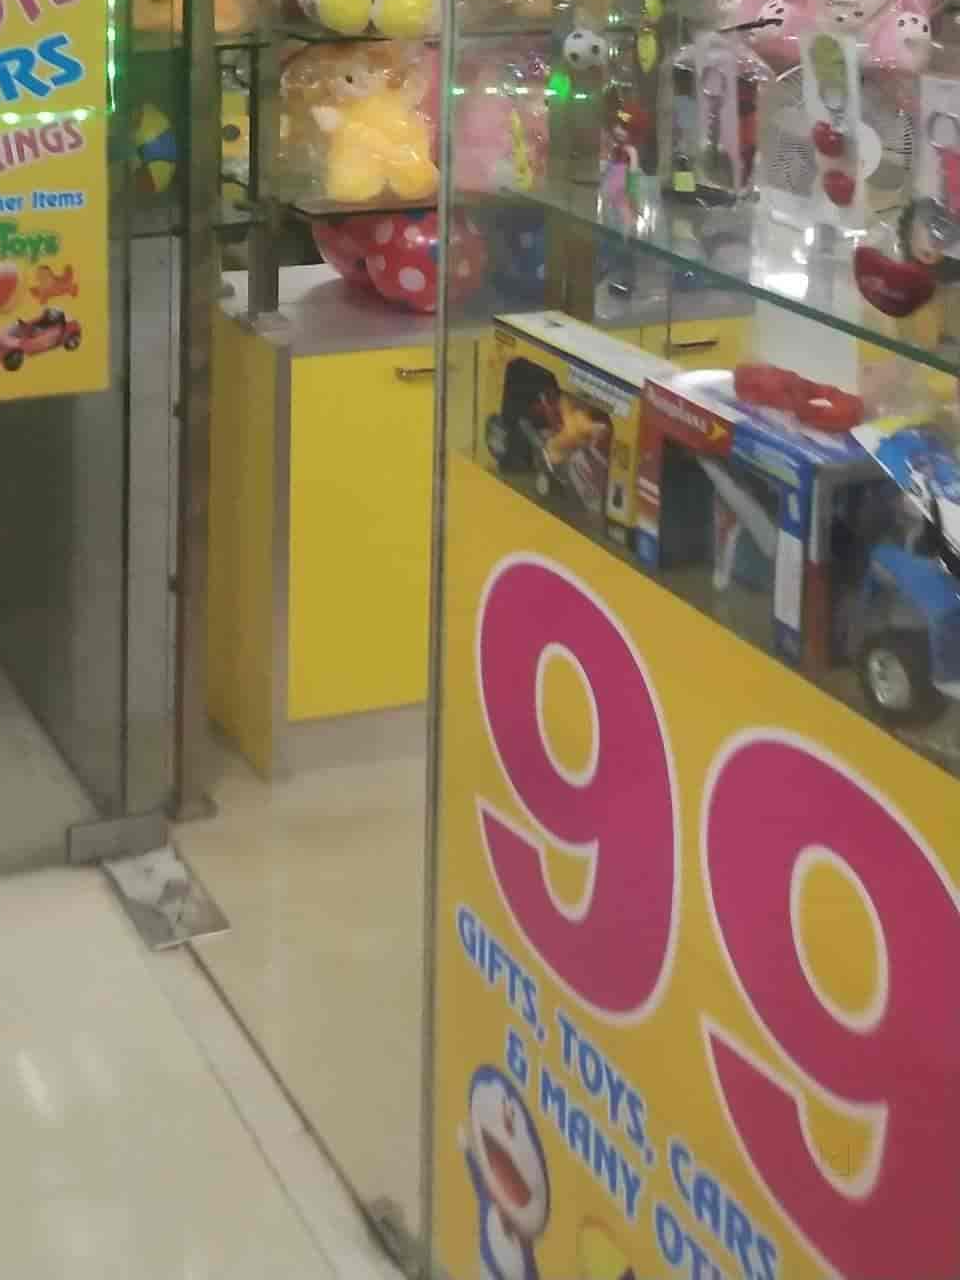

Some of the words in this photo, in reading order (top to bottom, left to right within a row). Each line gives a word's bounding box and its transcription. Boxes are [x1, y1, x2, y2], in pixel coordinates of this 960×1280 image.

[32, 191, 84, 209] Items
[476, 551, 960, 1280] 99
[542, 1067, 642, 1217] MANY
[655, 1202, 723, 1280] OT
